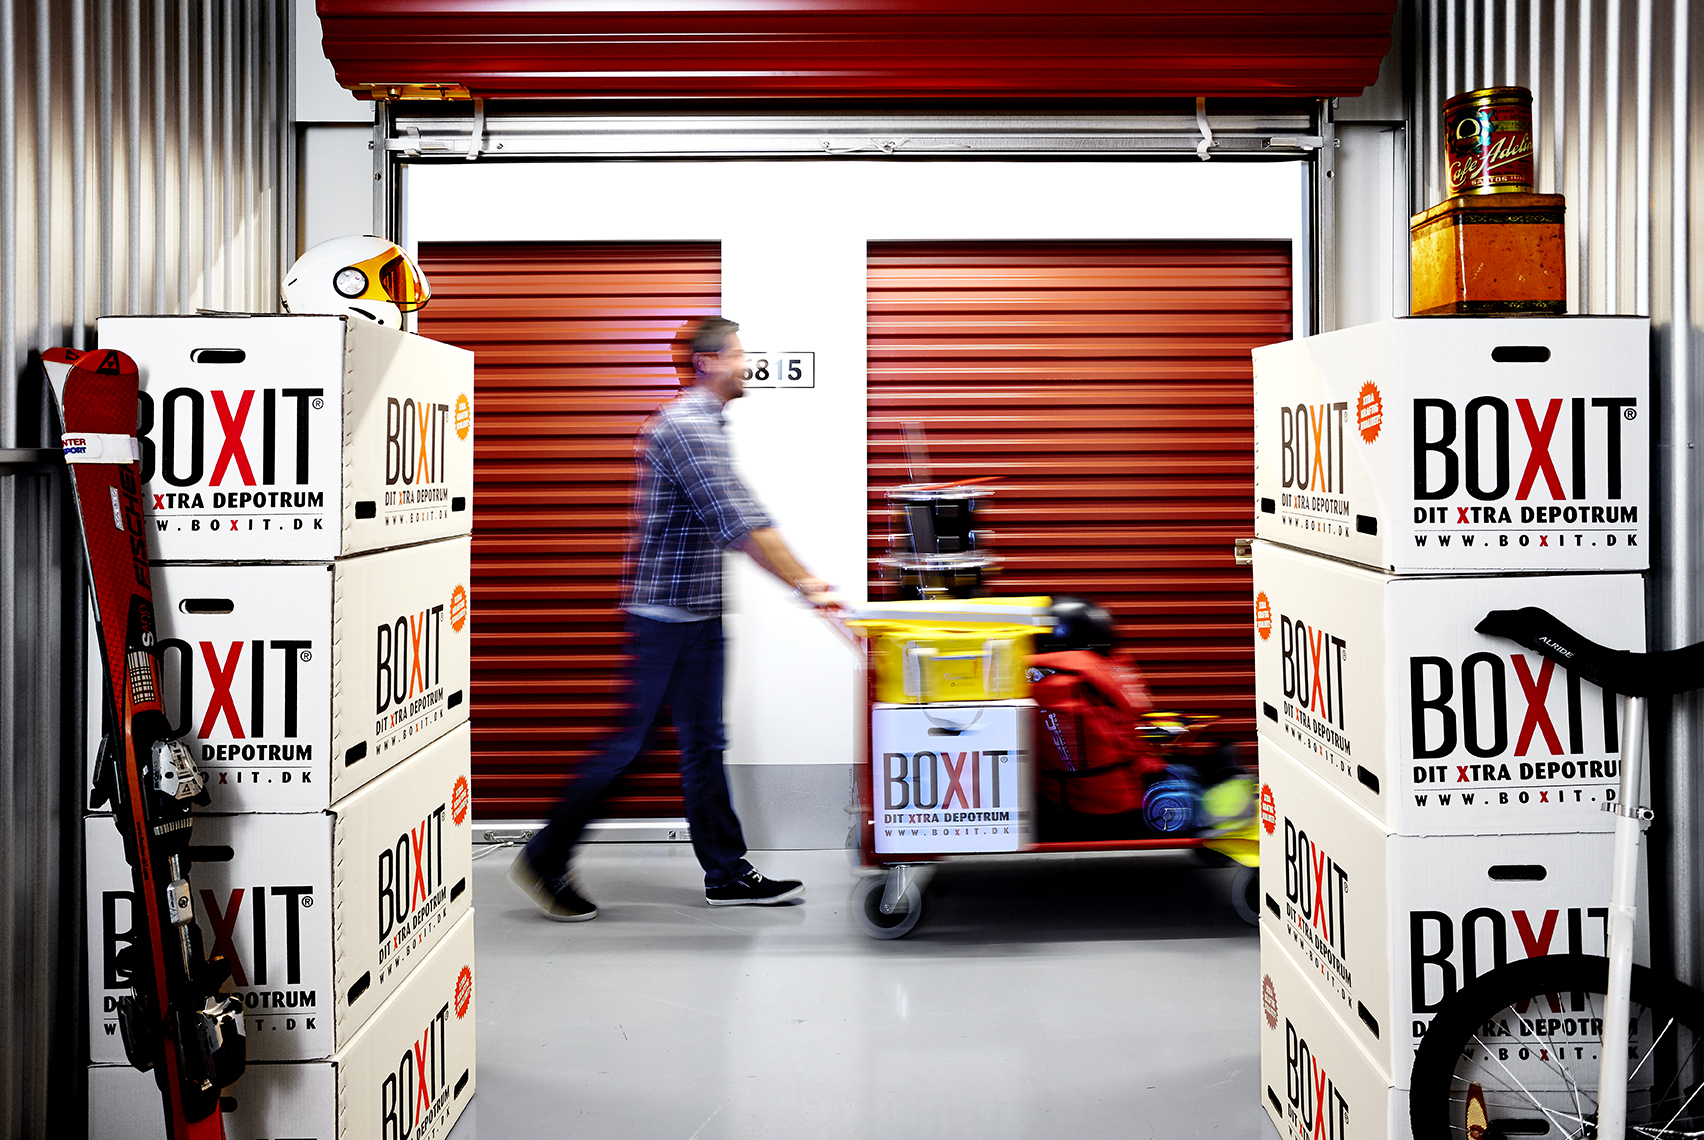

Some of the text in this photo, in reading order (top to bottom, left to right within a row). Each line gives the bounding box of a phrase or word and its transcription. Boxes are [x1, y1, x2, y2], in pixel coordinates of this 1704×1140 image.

[61, 438, 87, 448] NTER
[63, 446, 87, 455] PORT
[153, 492, 204, 509] XTRA
[213, 491, 323, 509] DEPOTRUM
[385, 488, 448, 506] DIT XTRA DEPOTRUM
[1282, 493, 1350, 516] DIT XTRA DEPOTRUM
[1413, 505, 1638, 524] DIT XTRA DEPOTRUM
[145, 518, 323, 531] W.BOXIT.DK
[1538, 636, 1575, 659] ALRIDE
[375, 687, 444, 736] DIT XTRA DEPOTRUM
[1283, 700, 1351, 756] DIT XTRA DEPOTRUM
[201, 743, 312, 761] DEPOTRUM
[201, 770, 312, 784] OXIT.DK
[1413, 759, 1621, 783] DIT XTRA DEPOTRU
[1414, 788, 1616, 807] WWW.BOXIT.D
[884, 811, 1010, 824] DIT XTRA DEPOTRUM
[379, 885, 447, 965] DIT XTRA DEPOTRUM
[1286, 902, 1352, 988] DIT XTRA DEPOTRUM
[1409, 906, 1610, 1014] BOXI
[222, 989, 316, 1009] OTRUM
[1519, 1018, 1638, 1037] DEPOTR
[1413, 1046, 1639, 1062] W.BOXIT.K
[416, 1084, 450, 1140] DEPOTRUM
